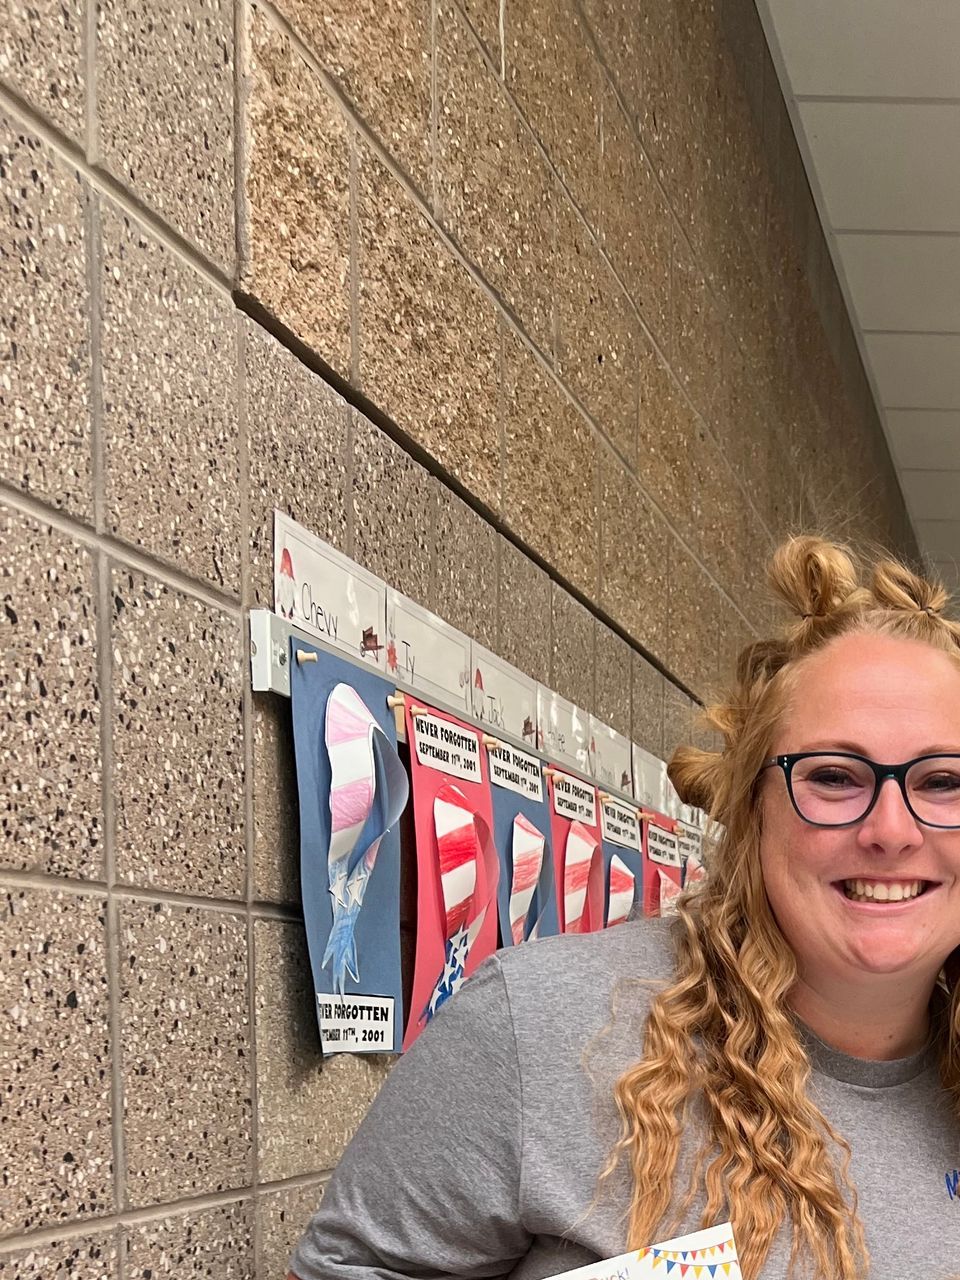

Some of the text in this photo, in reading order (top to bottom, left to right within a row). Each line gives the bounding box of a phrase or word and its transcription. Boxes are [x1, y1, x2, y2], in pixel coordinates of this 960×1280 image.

[301, 582, 339, 642] Chevy
[401, 640, 416, 685] Ty
[415, 717, 477, 754] NEVER FORGOTTEN
[419, 741, 450, 763] SEPTEMBER
[463, 758, 476, 772] 2001
[512, 752, 540, 778] FORGOTTEN
[493, 764, 520, 785] SEPTEMBER
[319, 1003, 389, 1022] EVER FORGOTTEN
[361, 1029, 385, 1042] 2001
